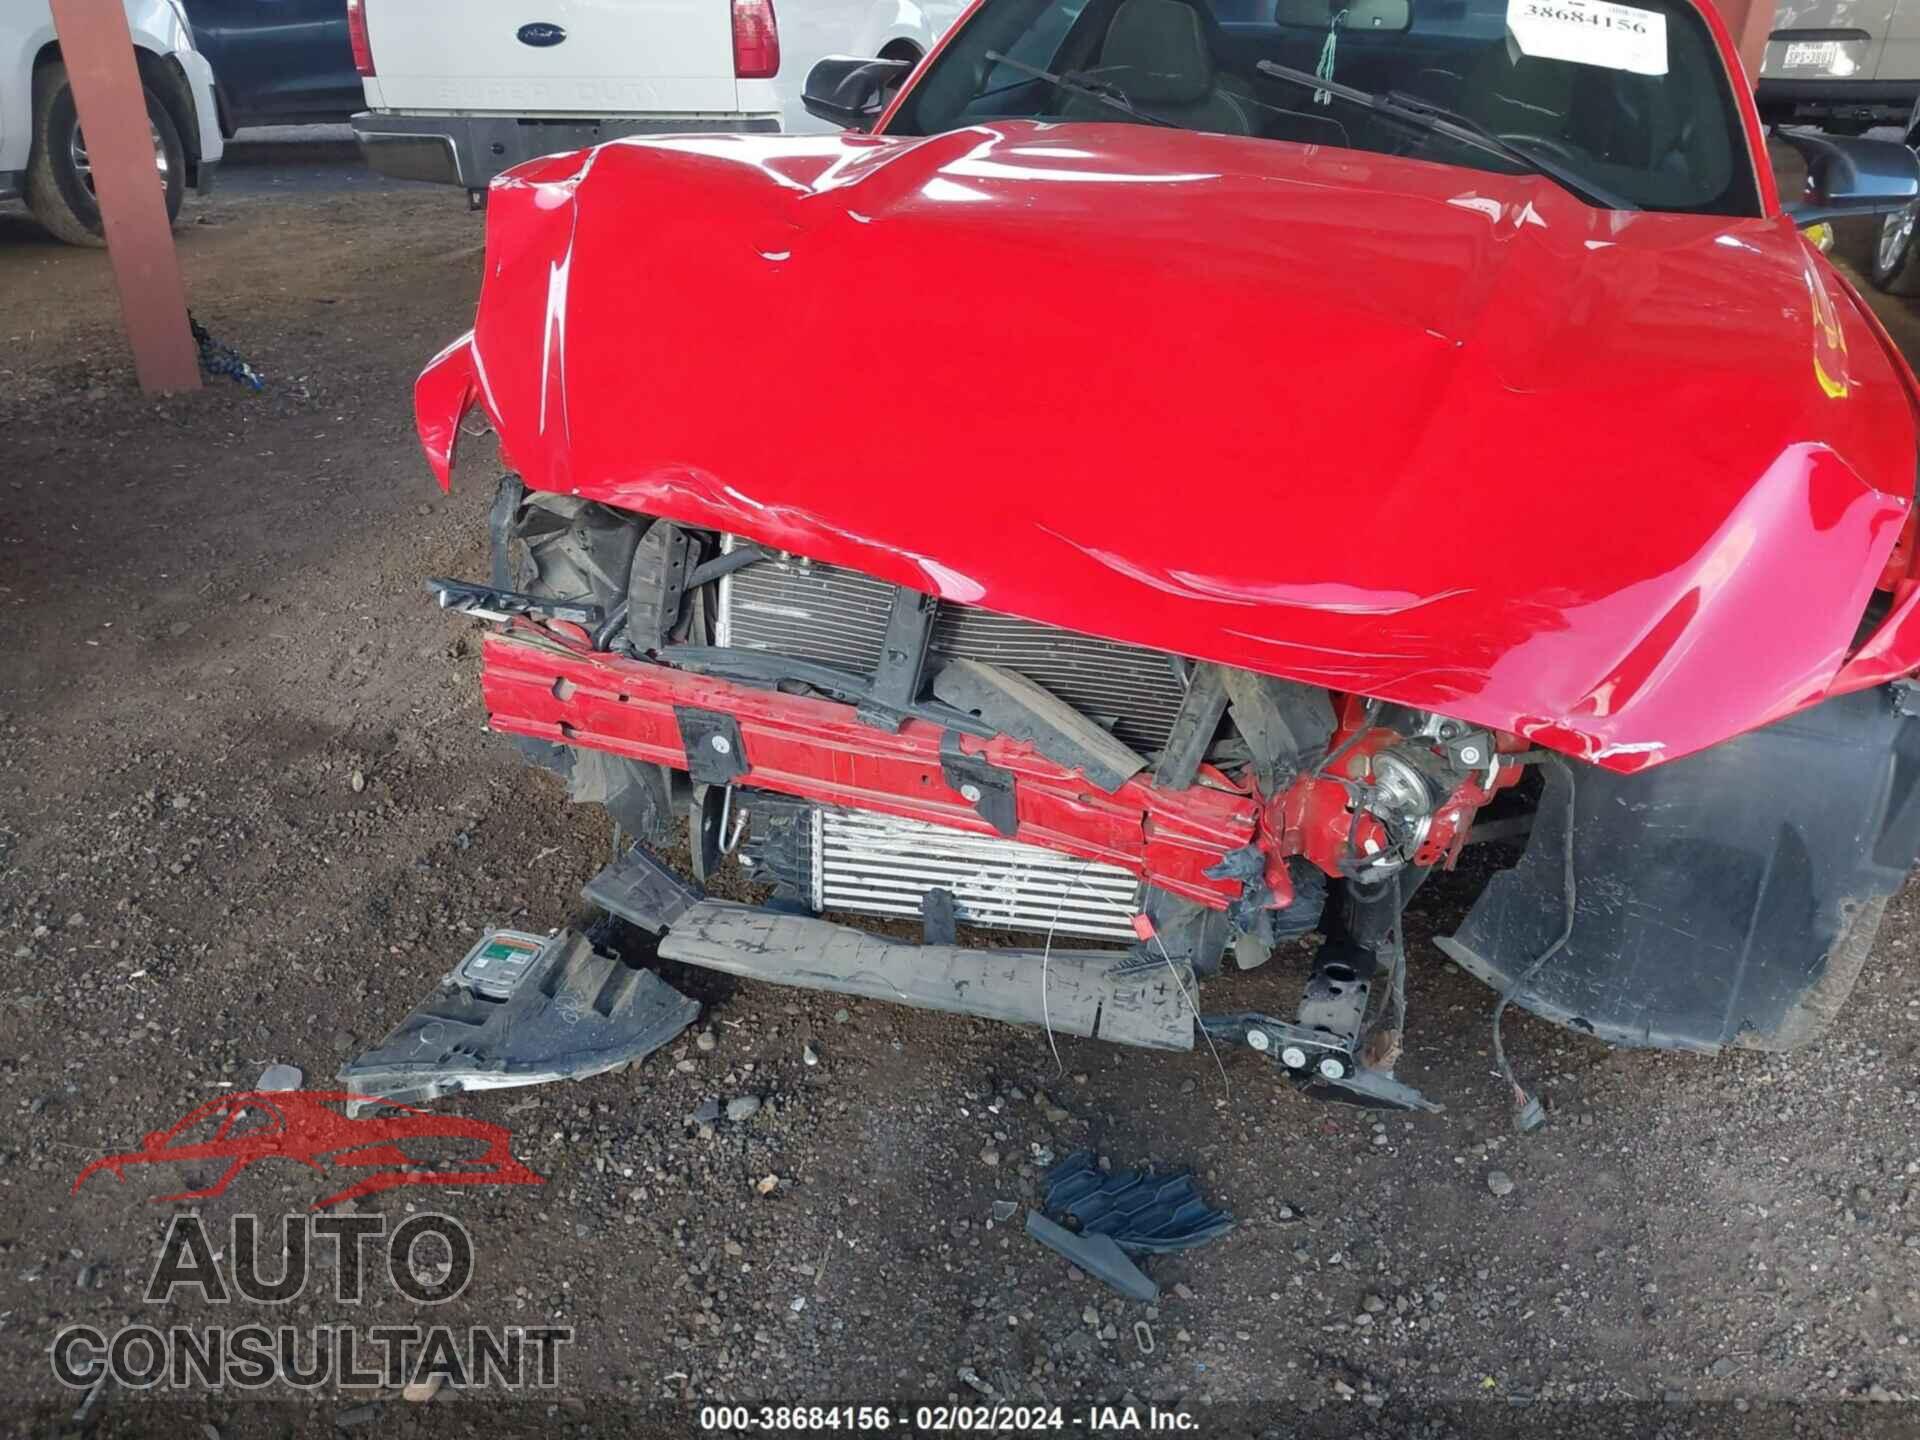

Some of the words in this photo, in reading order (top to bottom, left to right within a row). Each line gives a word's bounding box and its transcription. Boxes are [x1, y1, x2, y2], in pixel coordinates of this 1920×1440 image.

[1523, 3, 1647, 34] 38684156
[439, 81, 549, 104] SUPER
[572, 81, 669, 104] DUTY
